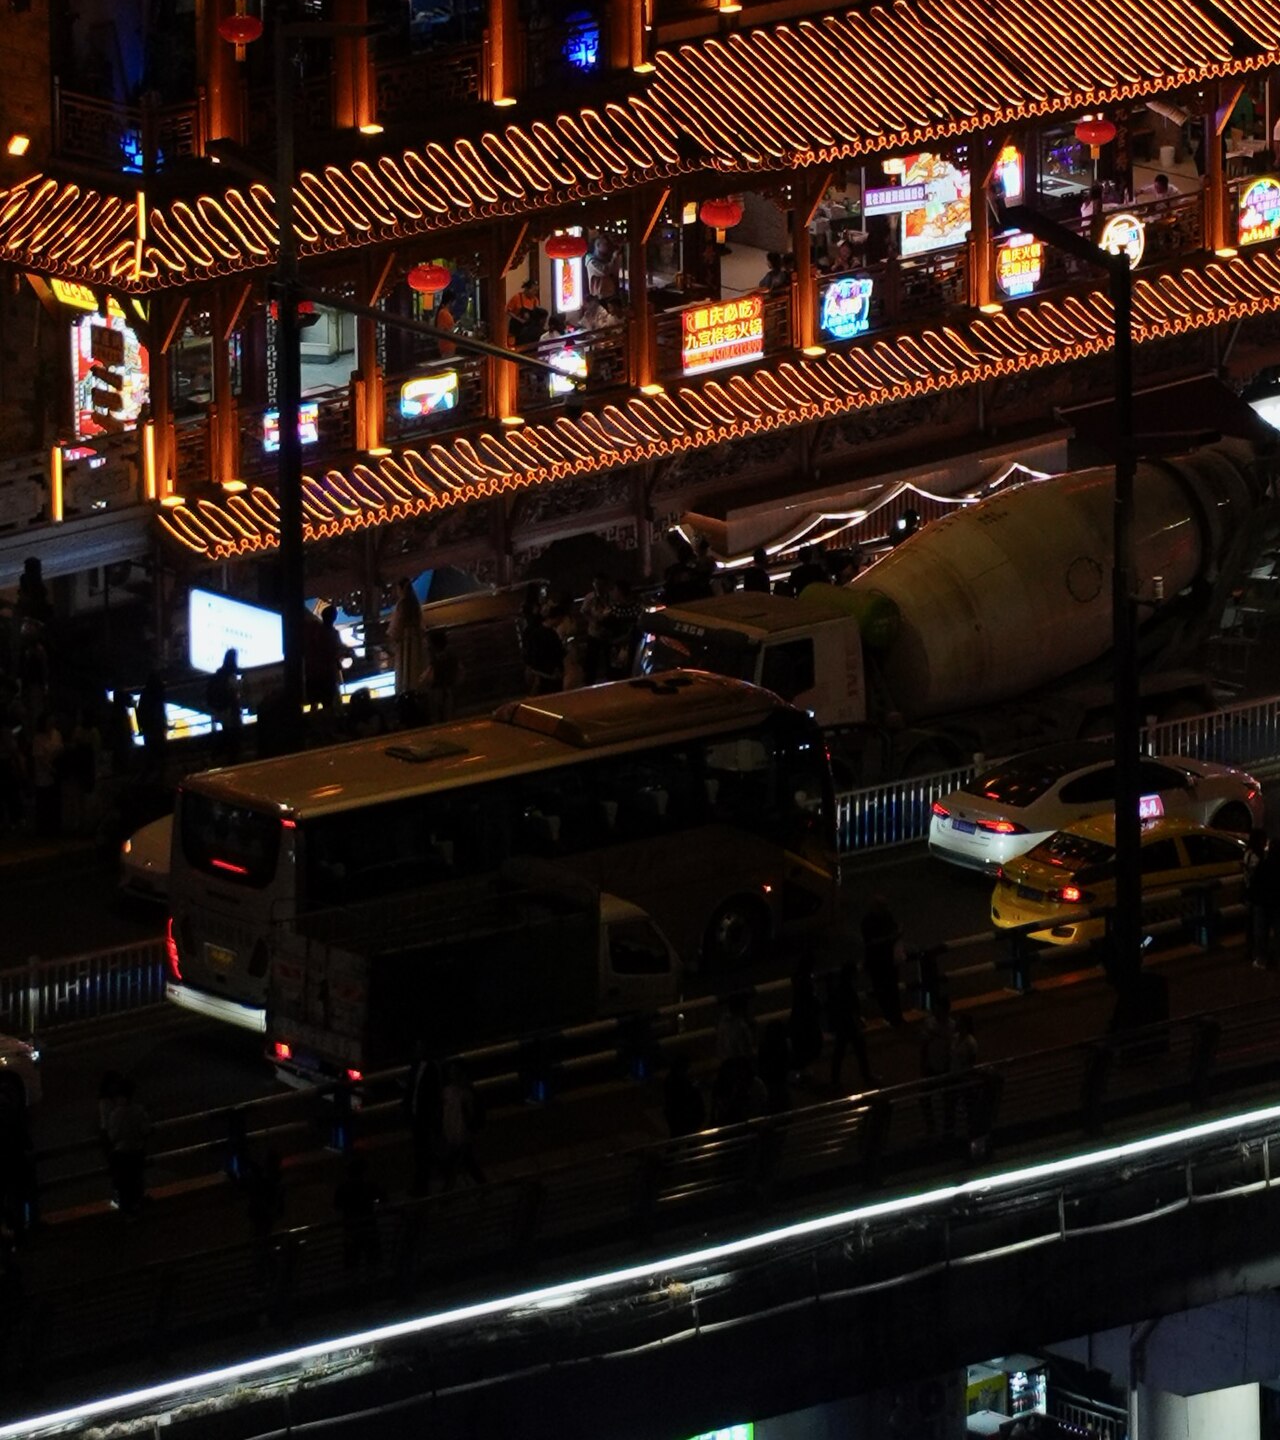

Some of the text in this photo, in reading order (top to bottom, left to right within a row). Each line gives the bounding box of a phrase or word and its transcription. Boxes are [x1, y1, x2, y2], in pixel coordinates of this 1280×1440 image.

[685, 318, 762, 350] 九宫格老火锅
